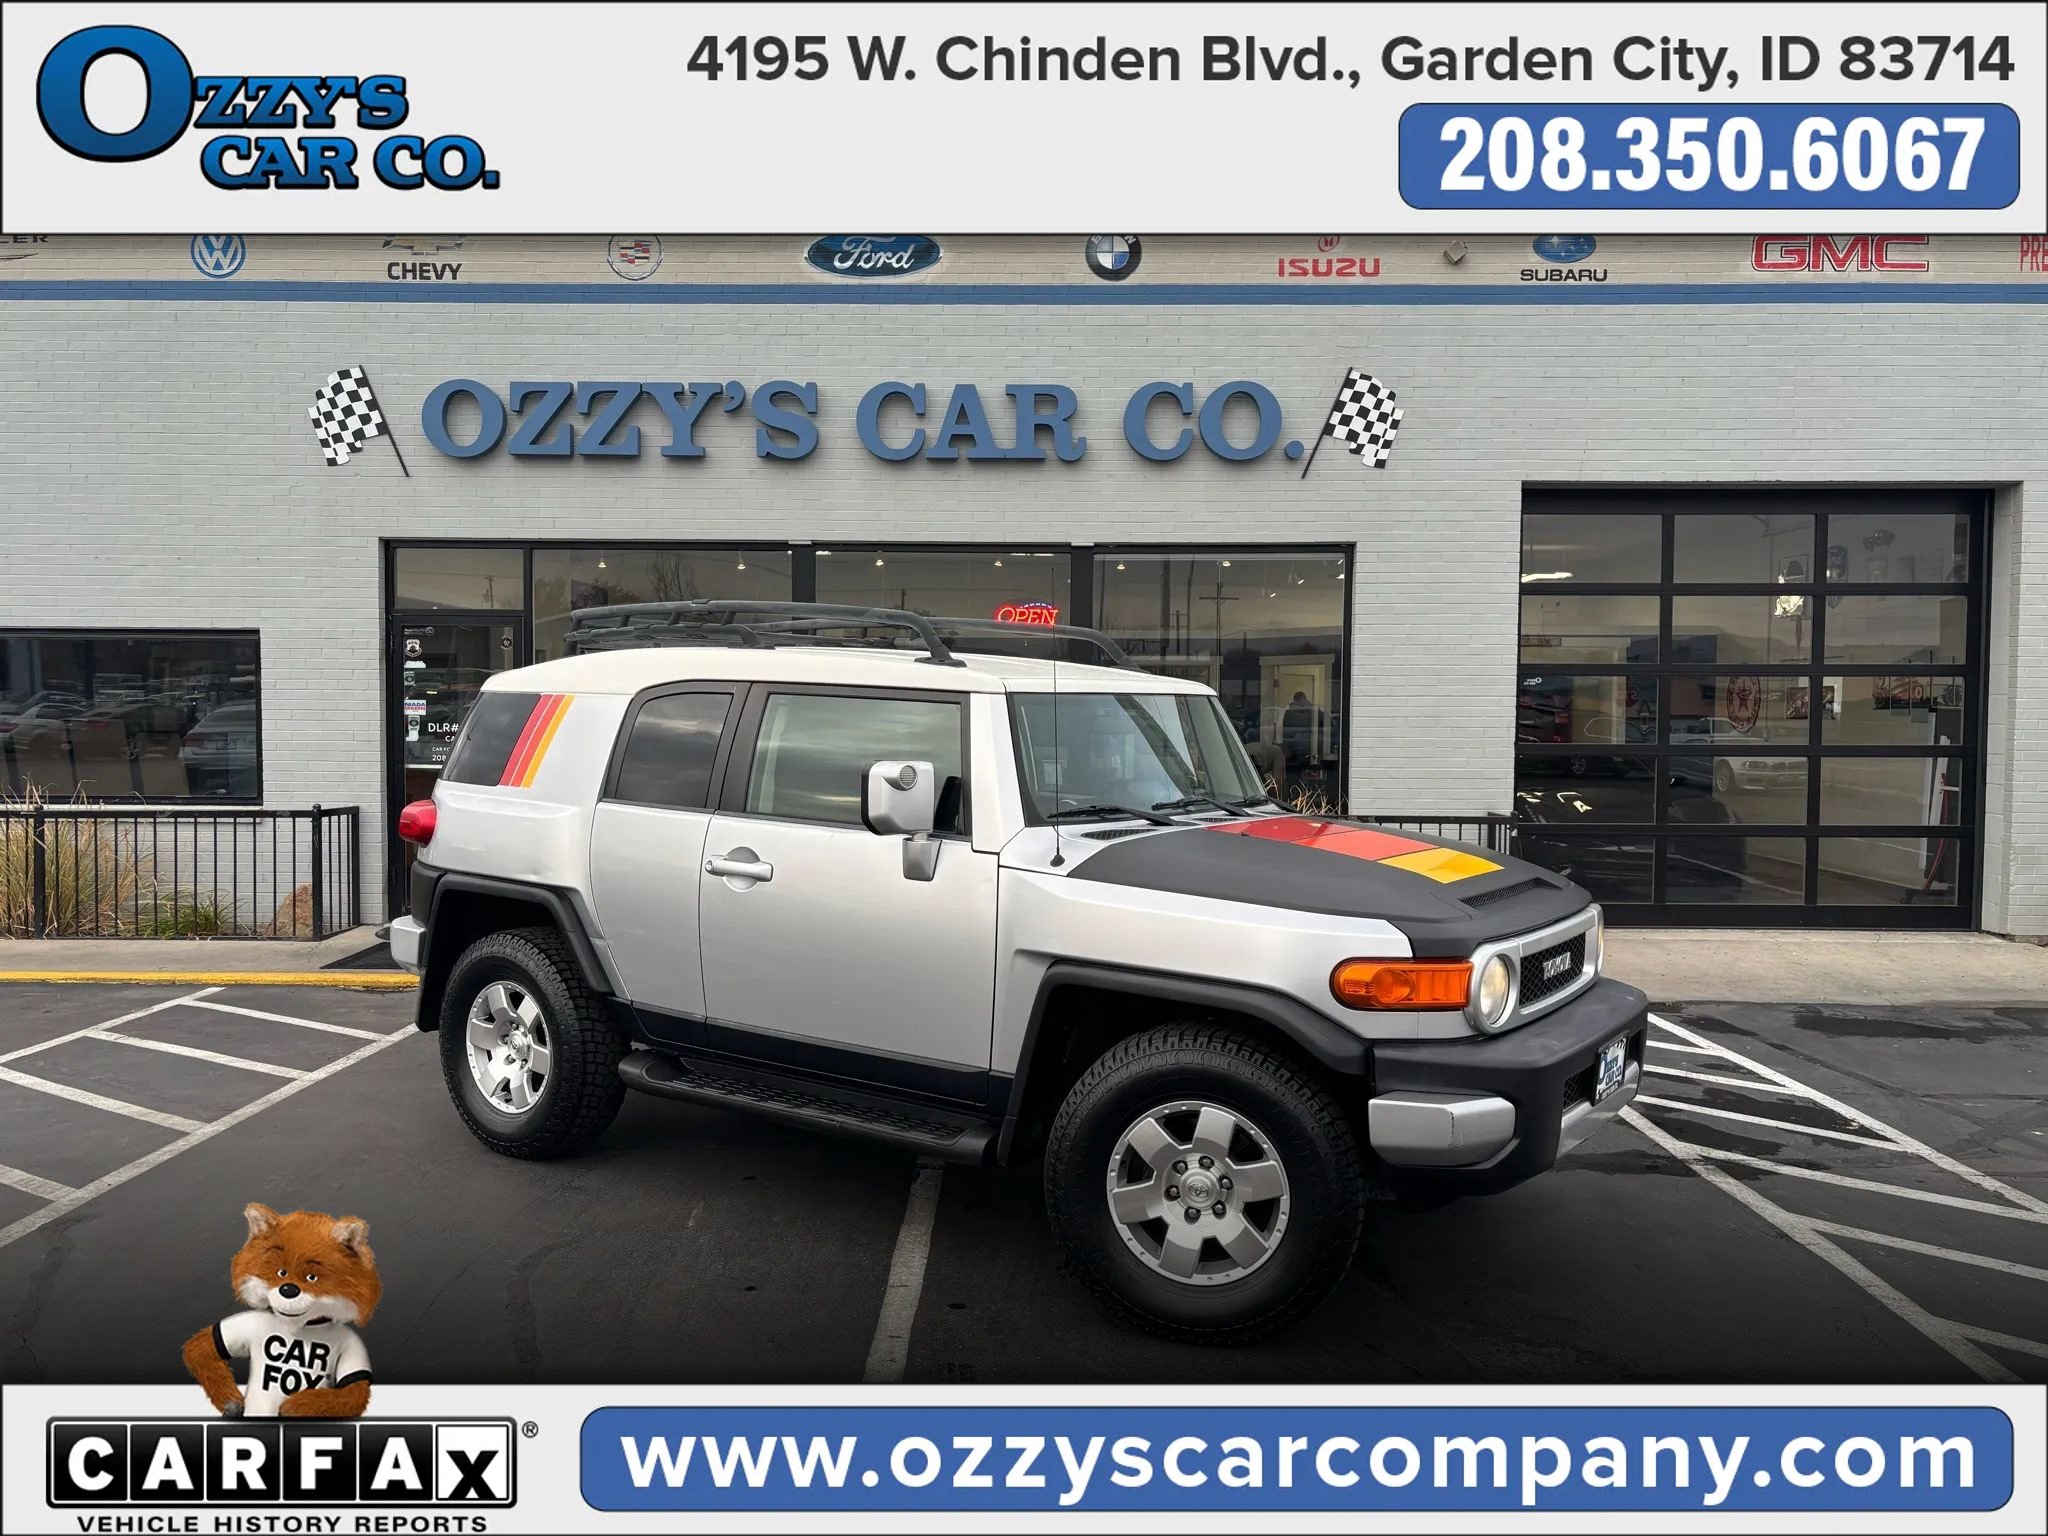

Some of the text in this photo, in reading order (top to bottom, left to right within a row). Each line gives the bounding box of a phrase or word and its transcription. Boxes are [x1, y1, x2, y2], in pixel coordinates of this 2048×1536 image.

[832, 234, 916, 271] Ford
[1751, 235, 1930, 272] GMC
[387, 262, 463, 281] CHEVY
[1278, 258, 1381, 278] ISUZU
[1520, 269, 1608, 283] SUBARU
[422, 379, 1305, 462] OZZY'S CAR CO.
[998, 606, 1059, 626] OPEN
[428, 722, 460, 733] DLR#
[1543, 952, 1571, 981] TOYOTA
